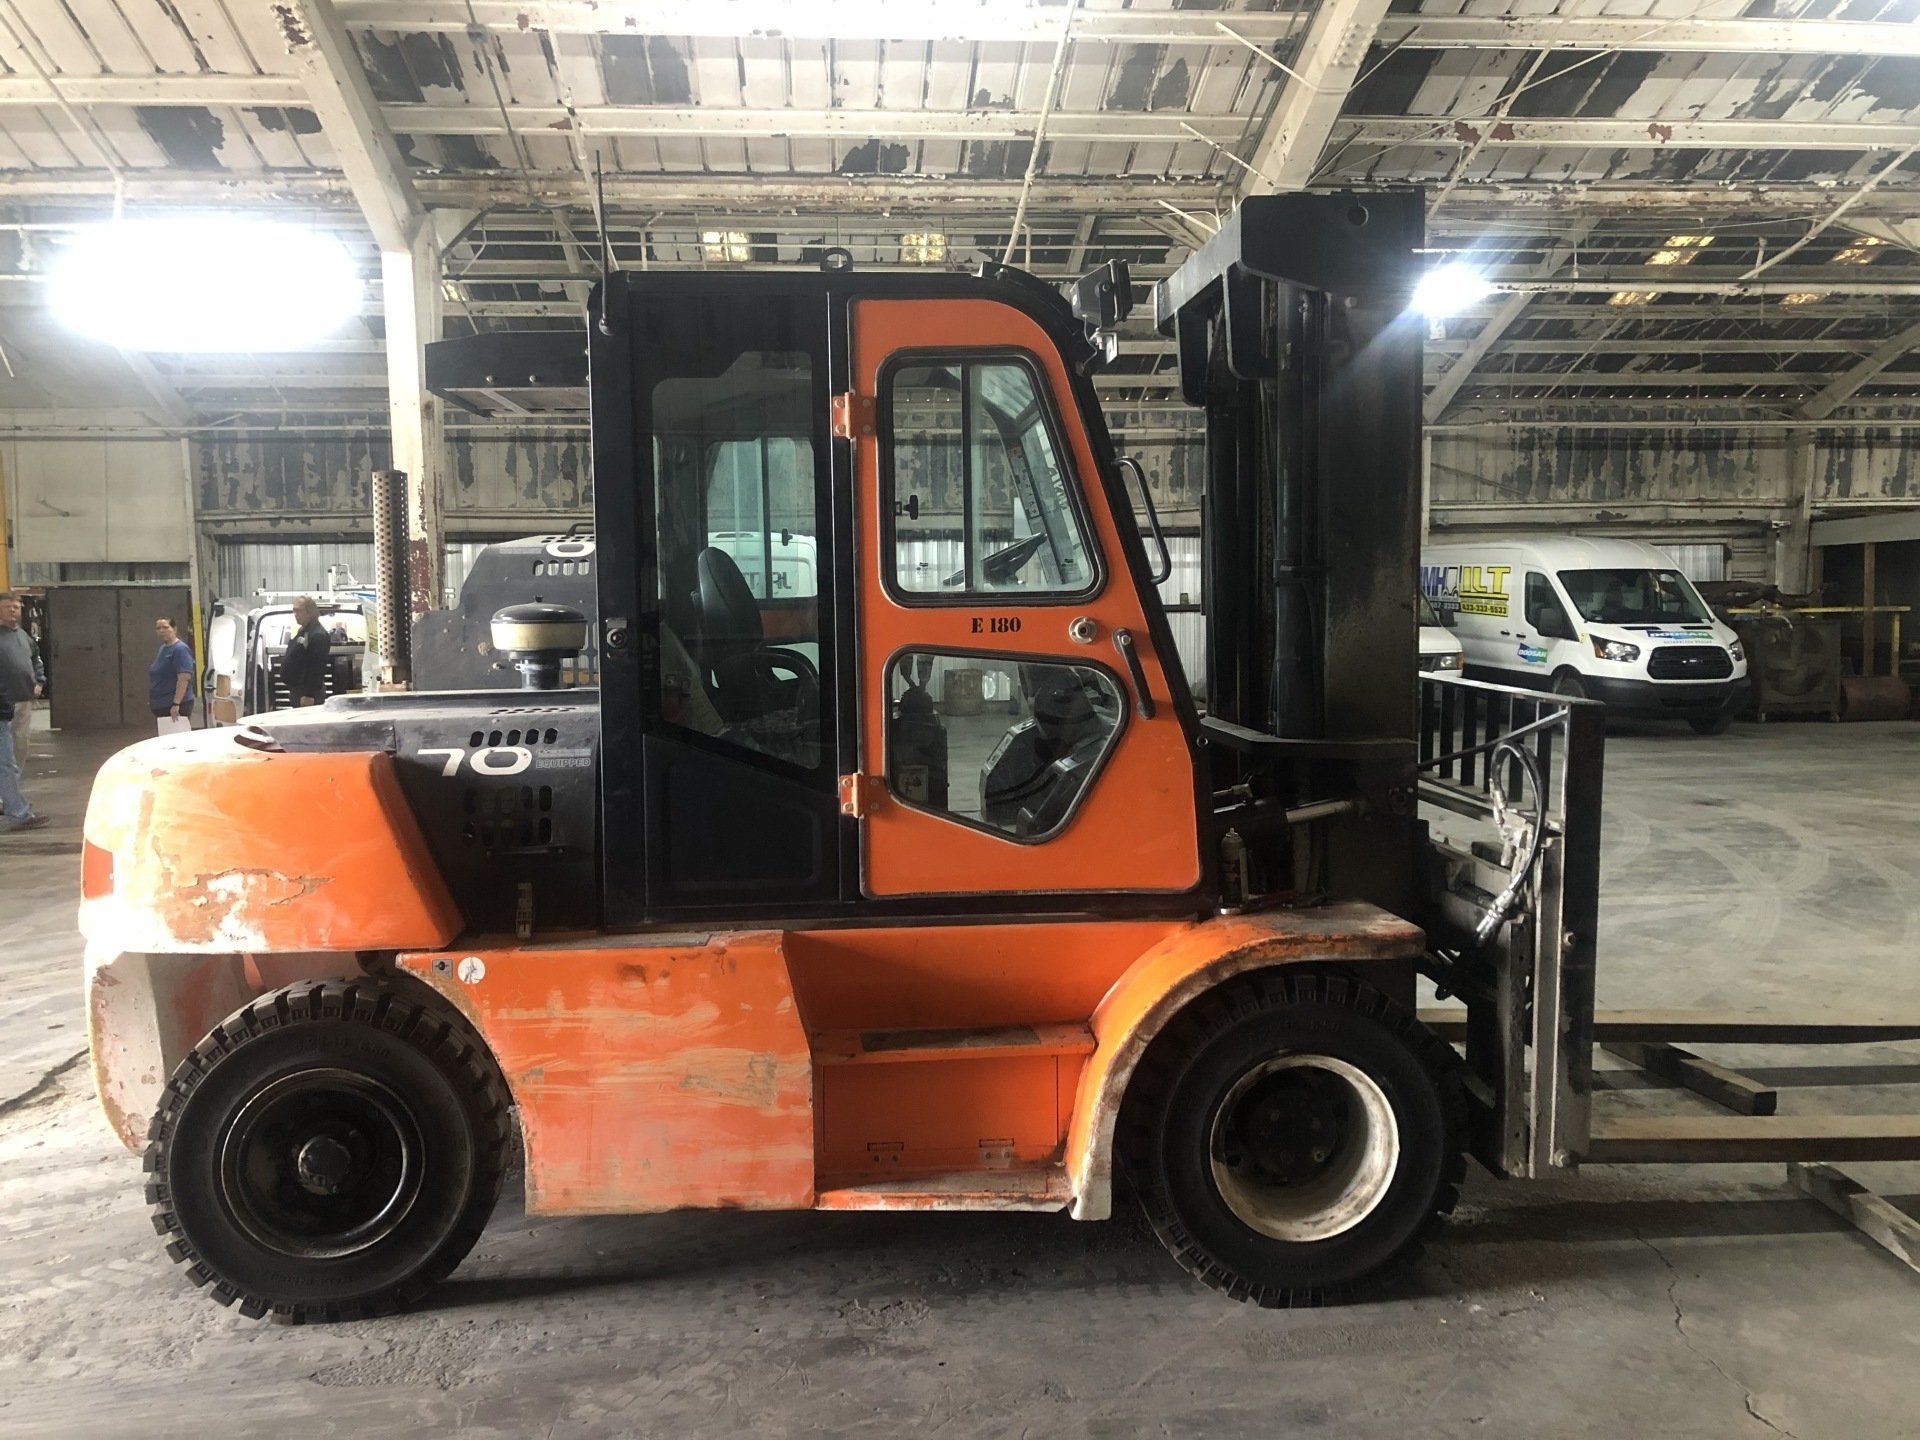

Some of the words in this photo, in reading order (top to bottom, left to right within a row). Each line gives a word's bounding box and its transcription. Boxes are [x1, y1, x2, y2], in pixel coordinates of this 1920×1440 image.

[971, 617, 984, 633] E
[990, 616, 1022, 633] 180
[417, 746, 533, 776] 70
[535, 758, 592, 769] EQUIPPED
